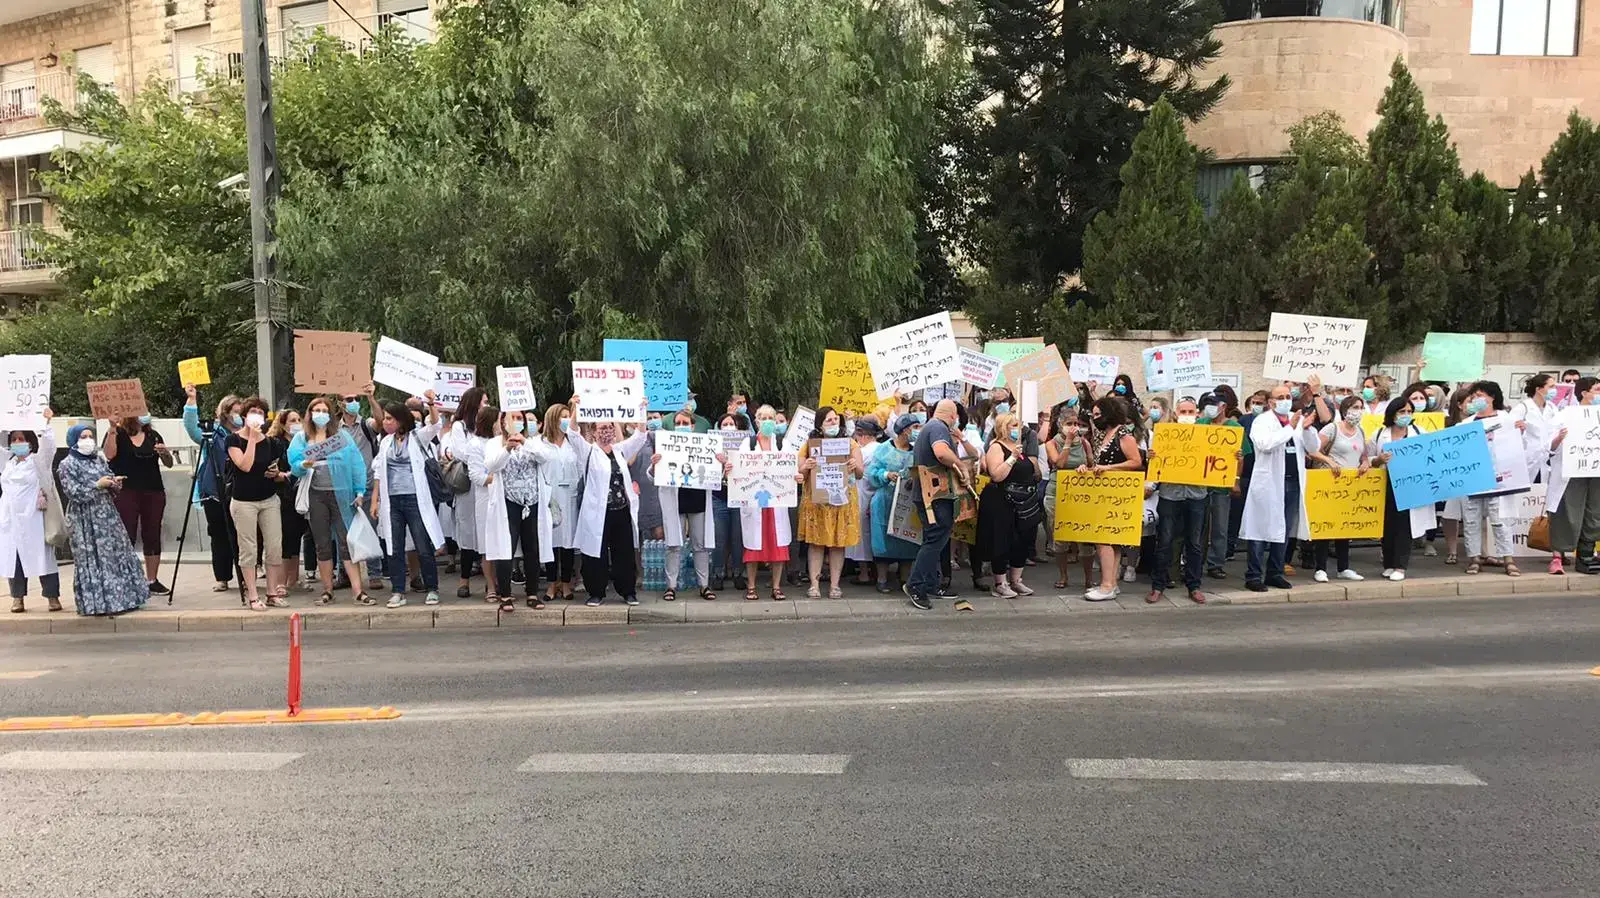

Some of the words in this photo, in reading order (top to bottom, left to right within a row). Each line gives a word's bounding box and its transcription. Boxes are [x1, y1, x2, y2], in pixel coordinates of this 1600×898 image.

[1303, 322, 1318, 334] כץ
[1324, 321, 1355, 331] ישראל
[1322, 338, 1356, 350] קריסת
[1173, 365, 1205, 375] המעבדות
[1332, 361, 1346, 374] על
[892, 374, 919, 388] סדר
[16, 393, 32, 407] 50
[579, 408, 613, 418] הרפואה
[618, 405, 634, 418] של
[692, 436, 704, 444] יום
[1156, 426, 1195, 442] מעבדה
[1207, 428, 1237, 445] בלי
[708, 438, 718, 446] כל
[1156, 456, 1197, 470] רפואה
[1425, 454, 1436, 466] א
[1204, 456, 1228, 479] אין
